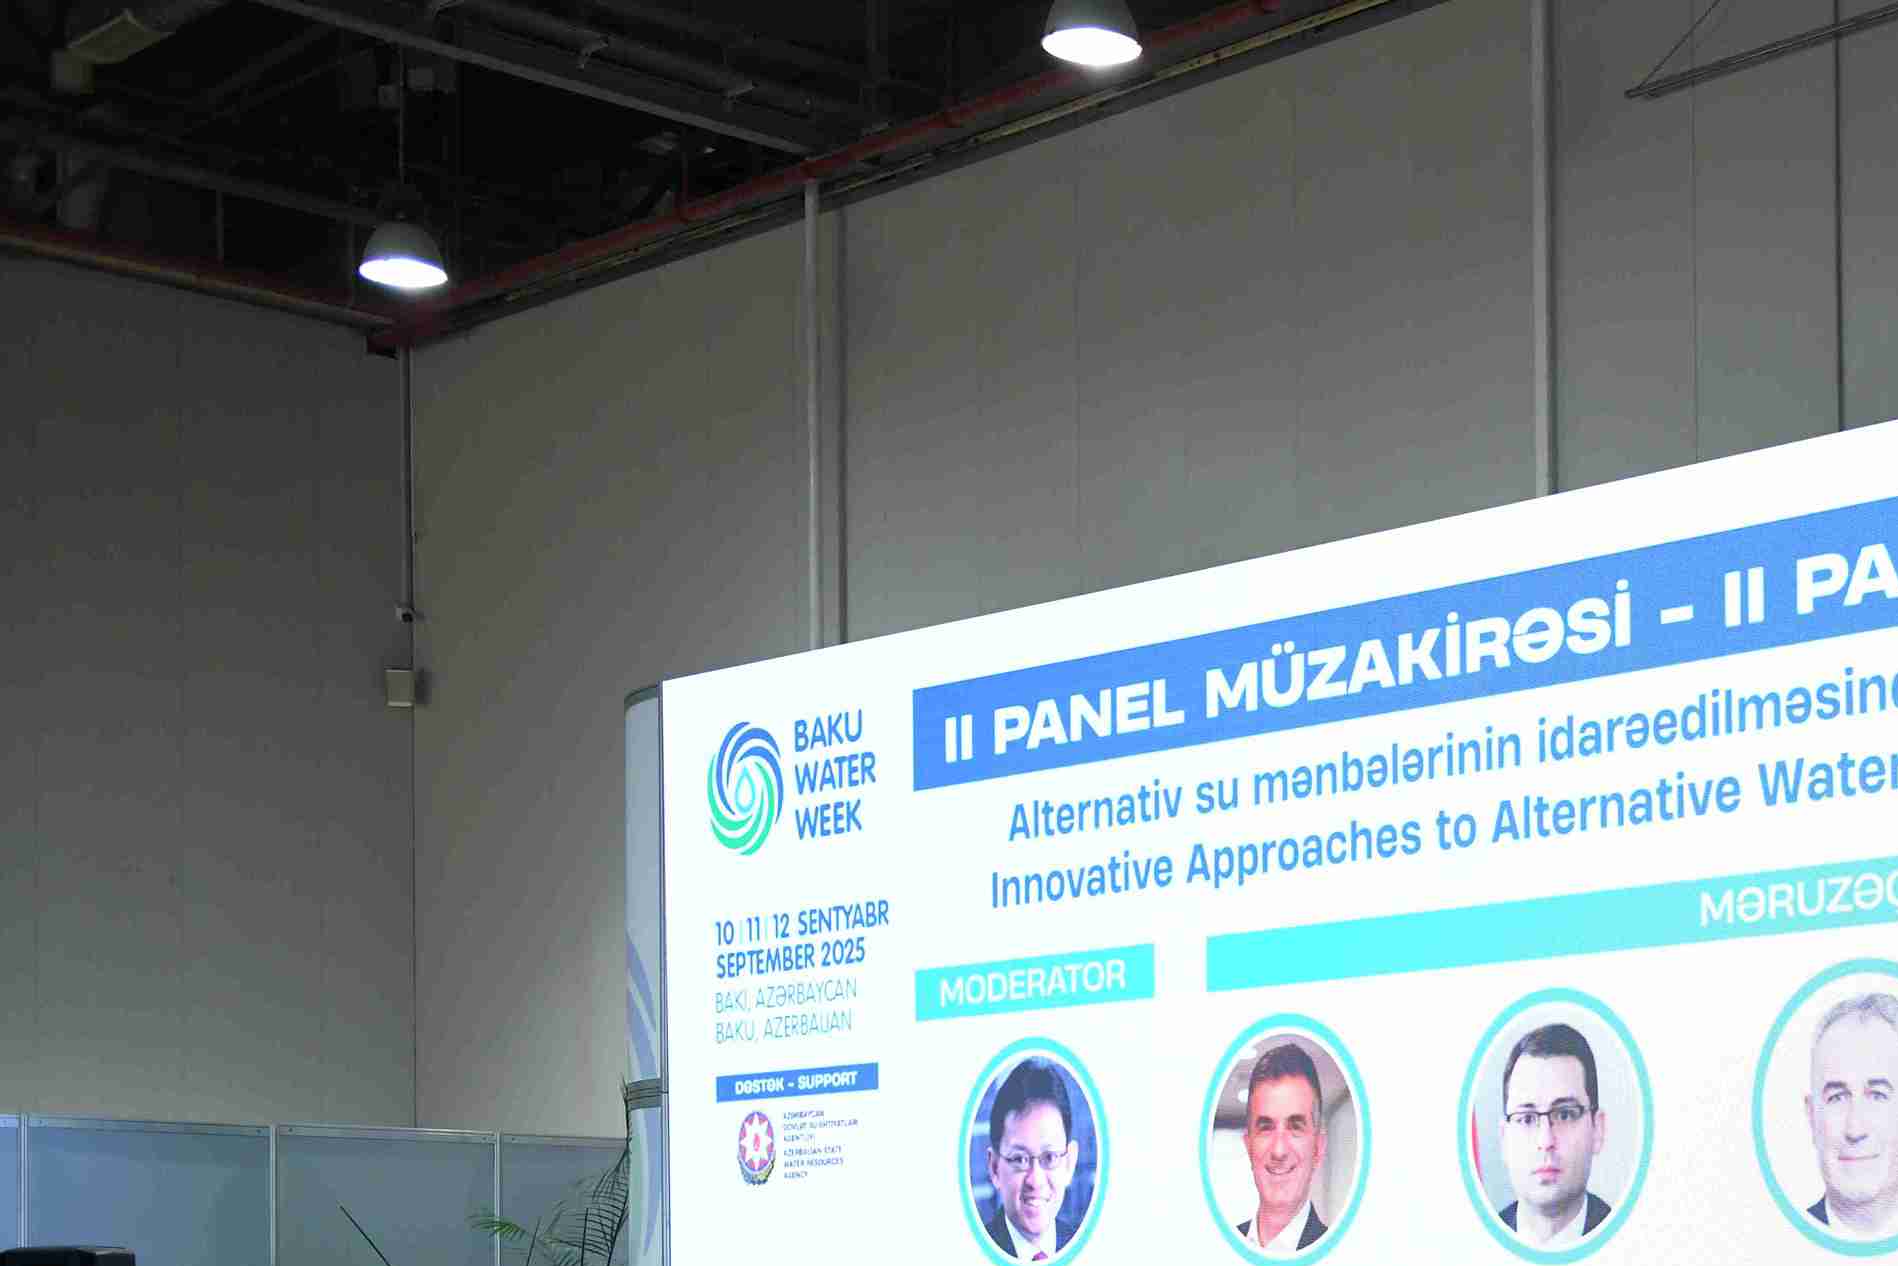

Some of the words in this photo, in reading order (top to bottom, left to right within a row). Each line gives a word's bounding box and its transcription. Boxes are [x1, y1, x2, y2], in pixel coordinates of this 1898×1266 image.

[944, 714, 974, 763] II
[993, 678, 1185, 754] PANEL
[1205, 579, 1632, 718] MÜZAKİRƏSİ
[1723, 566, 1765, 628] II
[794, 708, 863, 753] BAKU
[794, 750, 876, 795] WATER
[1007, 776, 1183, 843] Alternativ
[1195, 777, 1240, 815] su
[1252, 725, 1522, 806] mənbələrinin
[795, 798, 863, 840] WEEK
[991, 848, 1174, 909] Innovative
[1186, 817, 1421, 889] Approaches
[1436, 809, 1477, 852] to
[1491, 770, 1742, 843] Alternative
[797, 899, 890, 937] SENTYABR
[716, 943, 815, 979] SEPTEMBER
[820, 936, 866, 968] 2025
[939, 959, 1127, 1008] MODERATOR
[798, 1071, 858, 1090] SUPPORT
